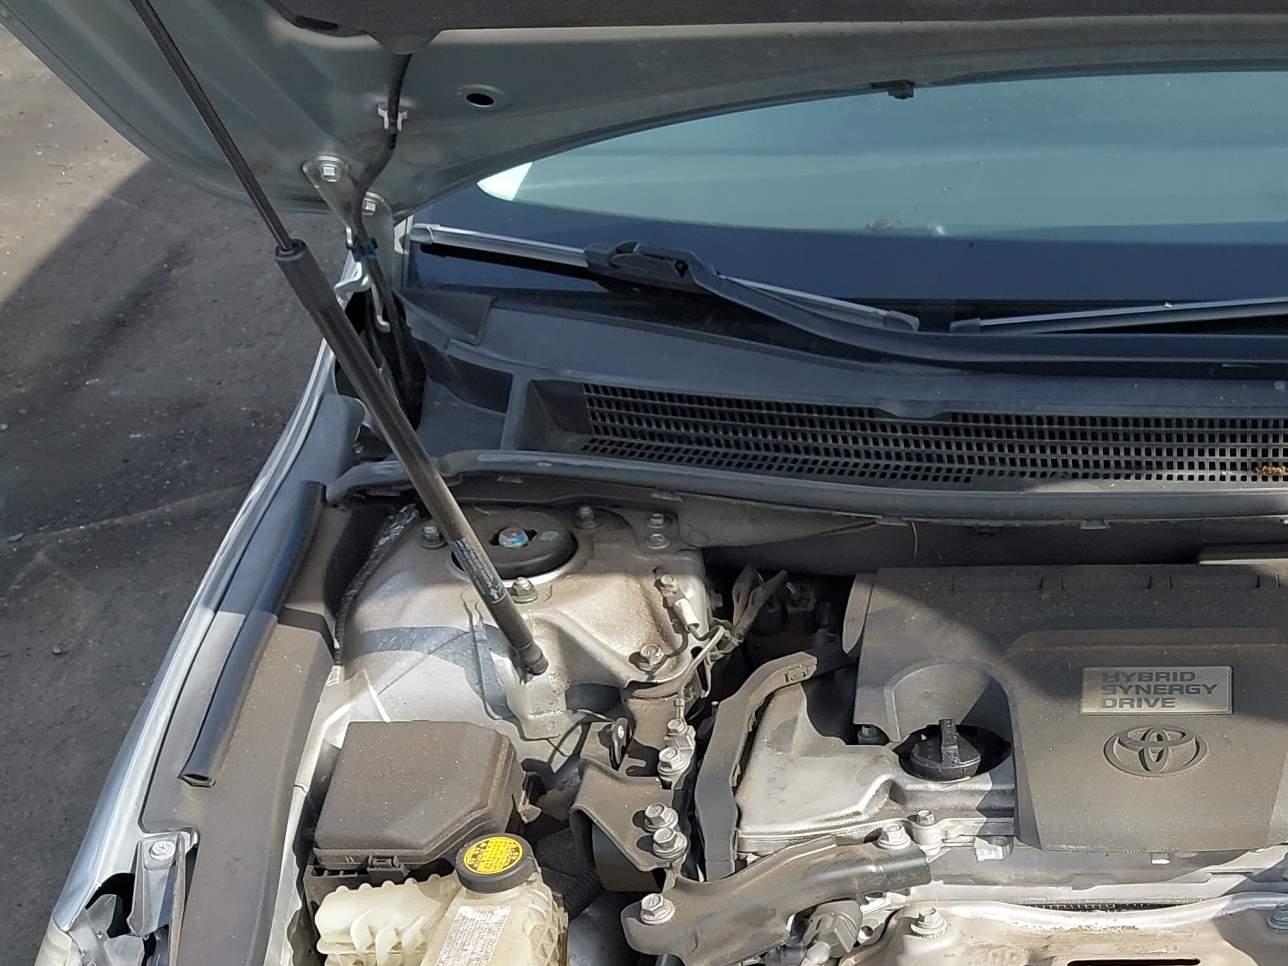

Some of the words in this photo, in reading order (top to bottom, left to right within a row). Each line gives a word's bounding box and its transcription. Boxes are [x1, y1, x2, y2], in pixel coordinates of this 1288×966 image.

[1101, 671, 1197, 683] HYBRID
[1101, 684, 1219, 695] SYNERGY
[1101, 697, 1176, 709] DRIVE
